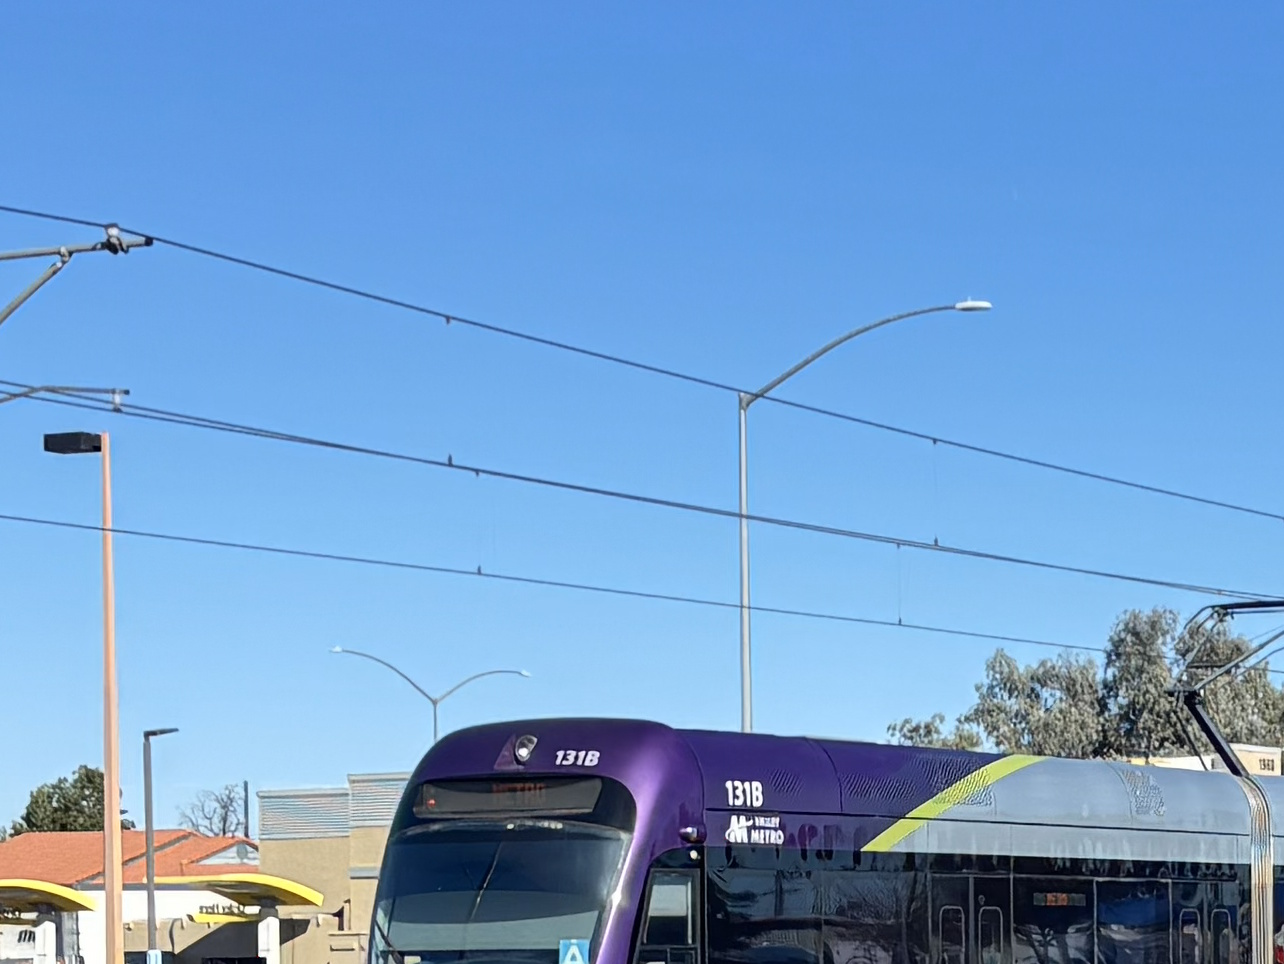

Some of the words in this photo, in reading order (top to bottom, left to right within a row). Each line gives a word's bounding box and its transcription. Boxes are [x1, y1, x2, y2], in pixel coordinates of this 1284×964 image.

[555, 750, 600, 766] 131B
[725, 780, 763, 807] 131B
[750, 829, 784, 845] METRO
